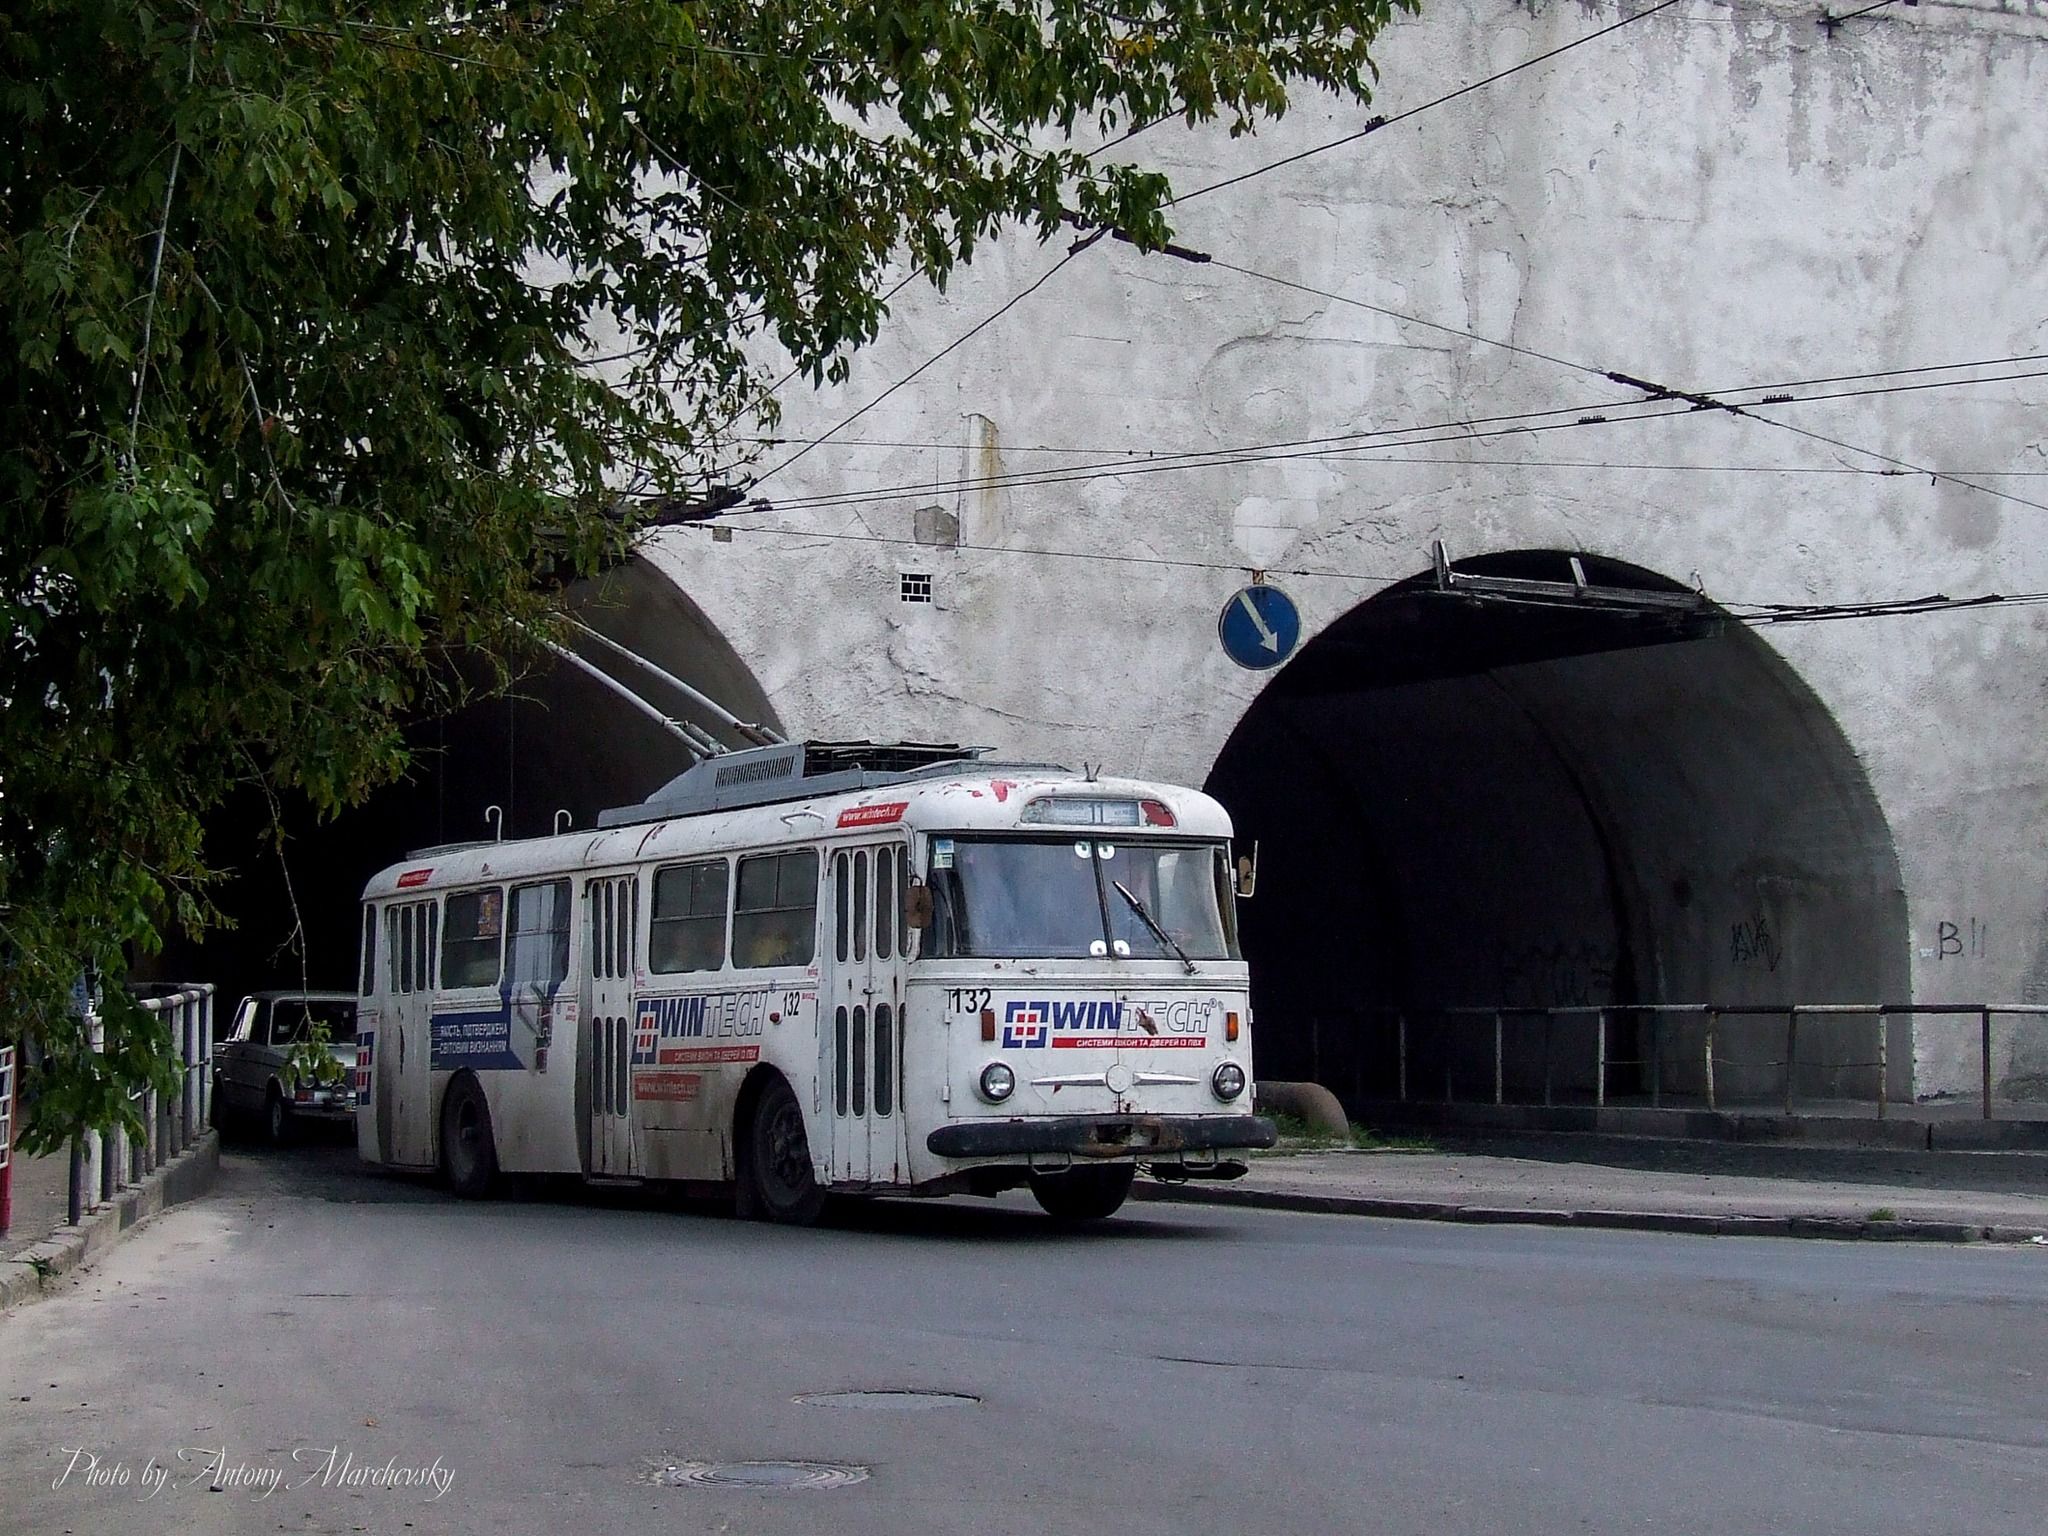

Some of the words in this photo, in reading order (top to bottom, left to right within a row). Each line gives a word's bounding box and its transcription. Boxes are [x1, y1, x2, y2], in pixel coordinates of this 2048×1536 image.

[1087, 803, 1104, 824] 11
[783, 992, 800, 1016] 132
[952, 988, 991, 1014] 132
[661, 991, 769, 1038] WINTECH
[1076, 1039, 1114, 1047] СИСТЕМИ
[1149, 1038, 1179, 1048] ДВЕРЕЙ
